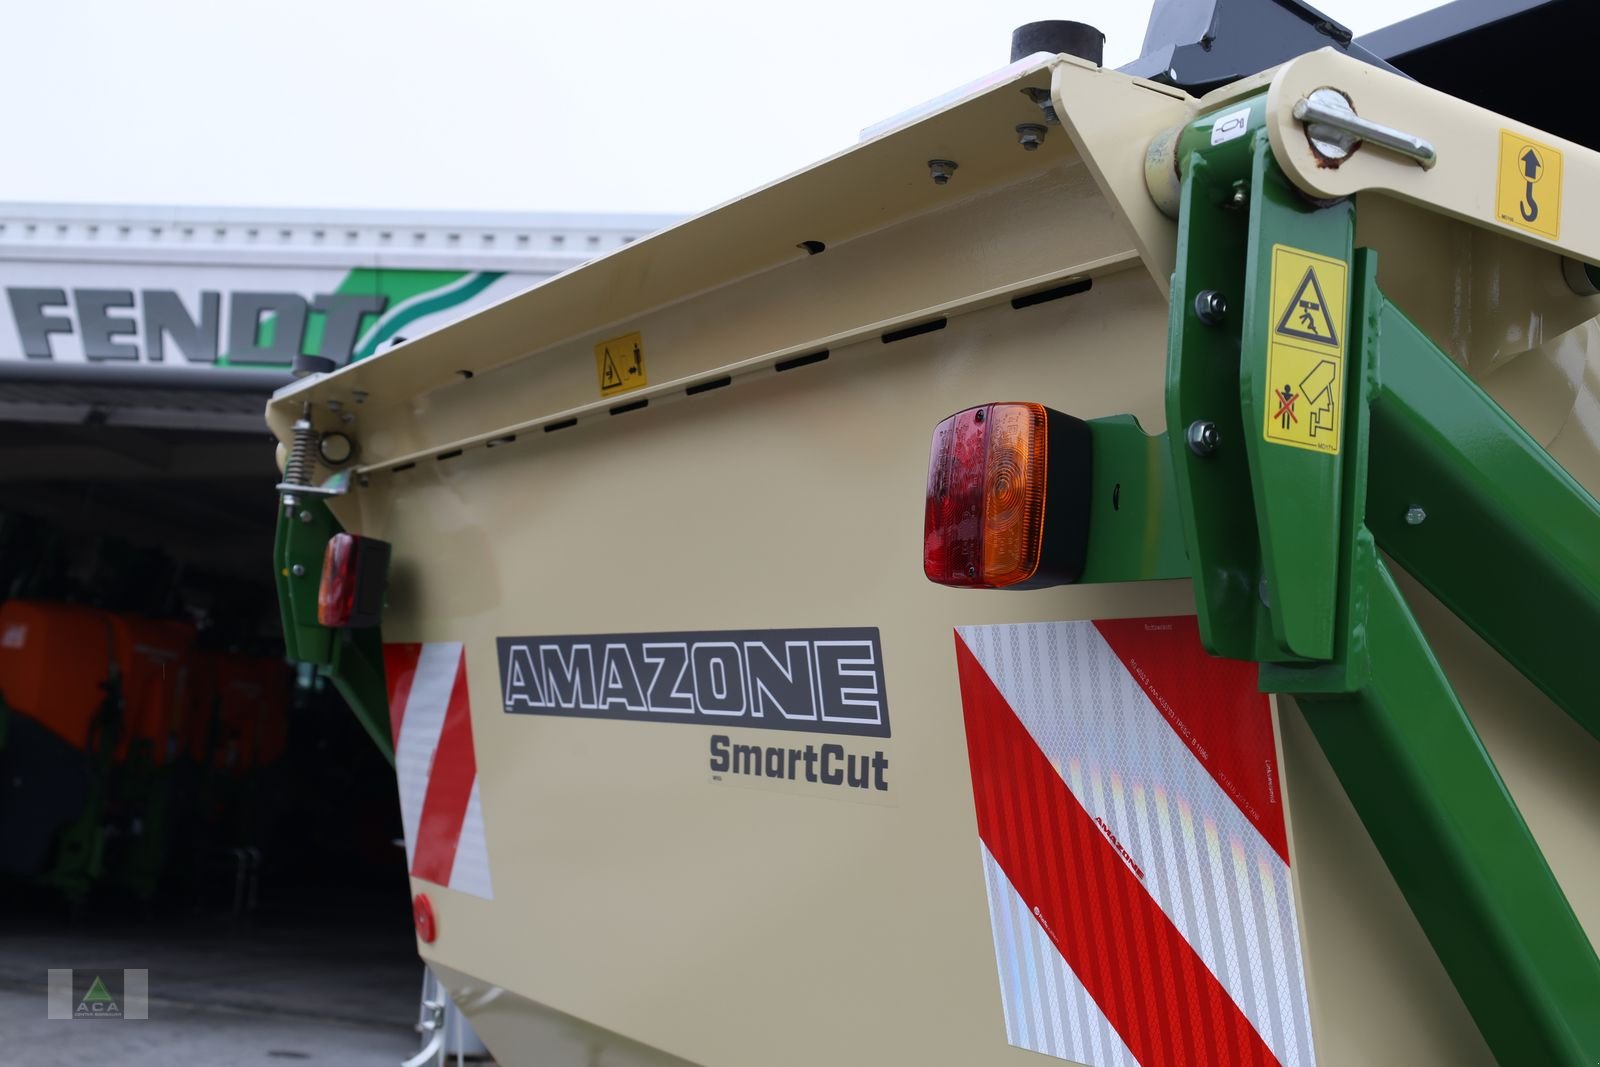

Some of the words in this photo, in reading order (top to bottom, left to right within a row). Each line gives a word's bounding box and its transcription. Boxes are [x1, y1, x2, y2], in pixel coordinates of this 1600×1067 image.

[5, 287, 389, 366] FENDT
[505, 640, 882, 725] AMAZONE
[710, 735, 888, 791] SmartCut
[1096, 817, 1145, 879] AMAZONE
